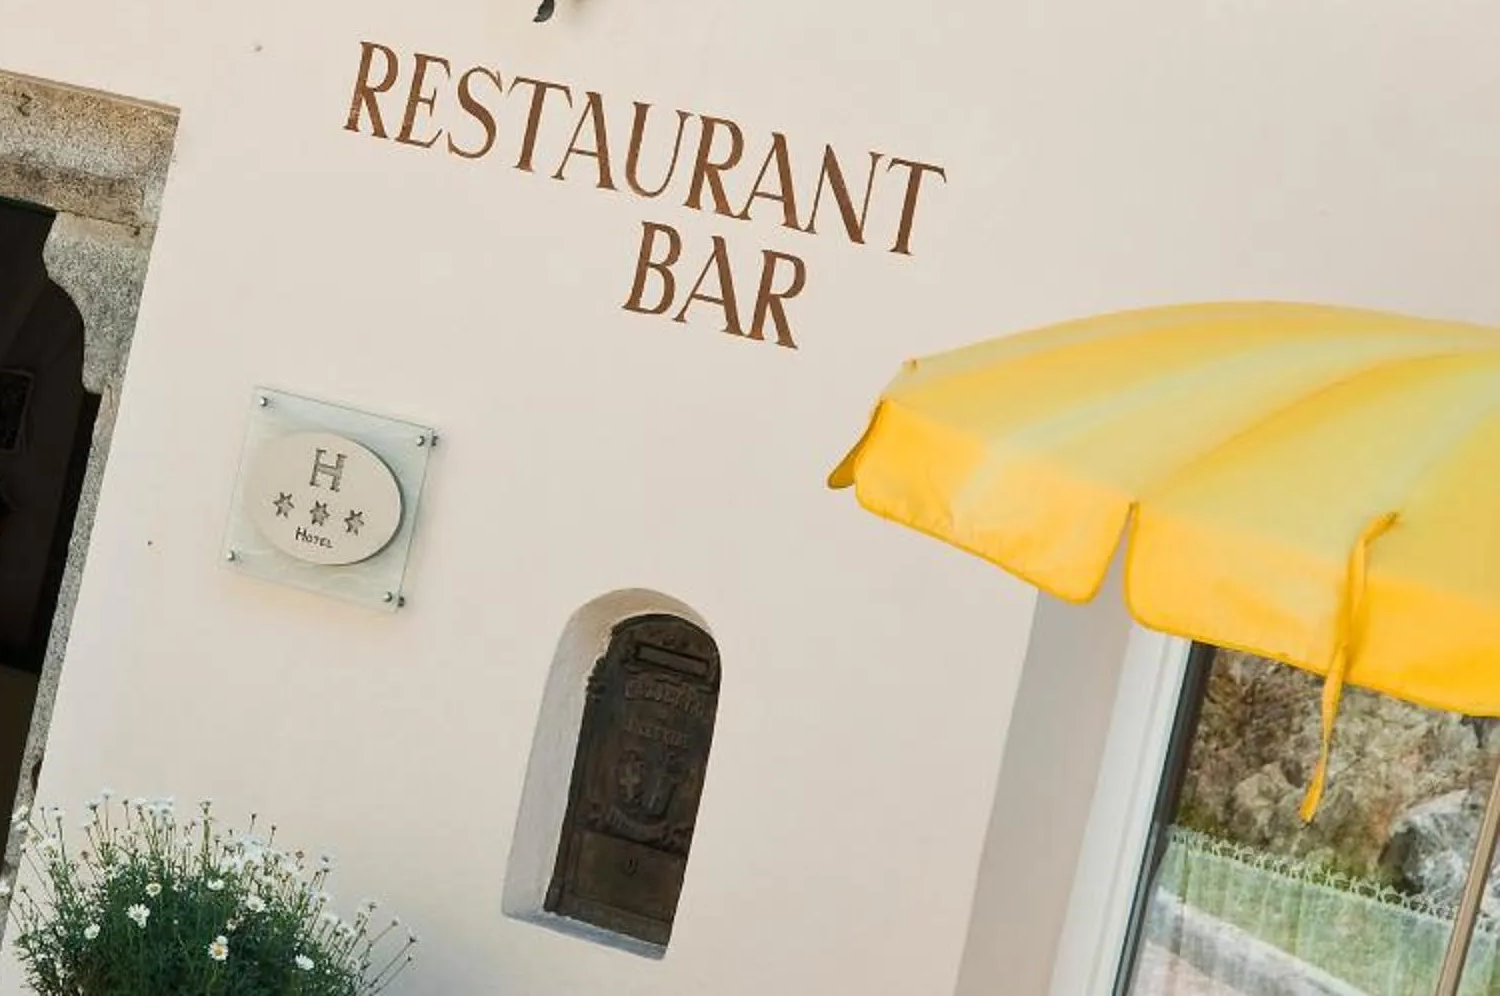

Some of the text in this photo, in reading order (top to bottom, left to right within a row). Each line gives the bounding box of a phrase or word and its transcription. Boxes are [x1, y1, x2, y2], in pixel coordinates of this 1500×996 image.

[342, 40, 947, 256] RESTAURANT
[621, 220, 807, 350] BAR
[309, 447, 349, 493] H
